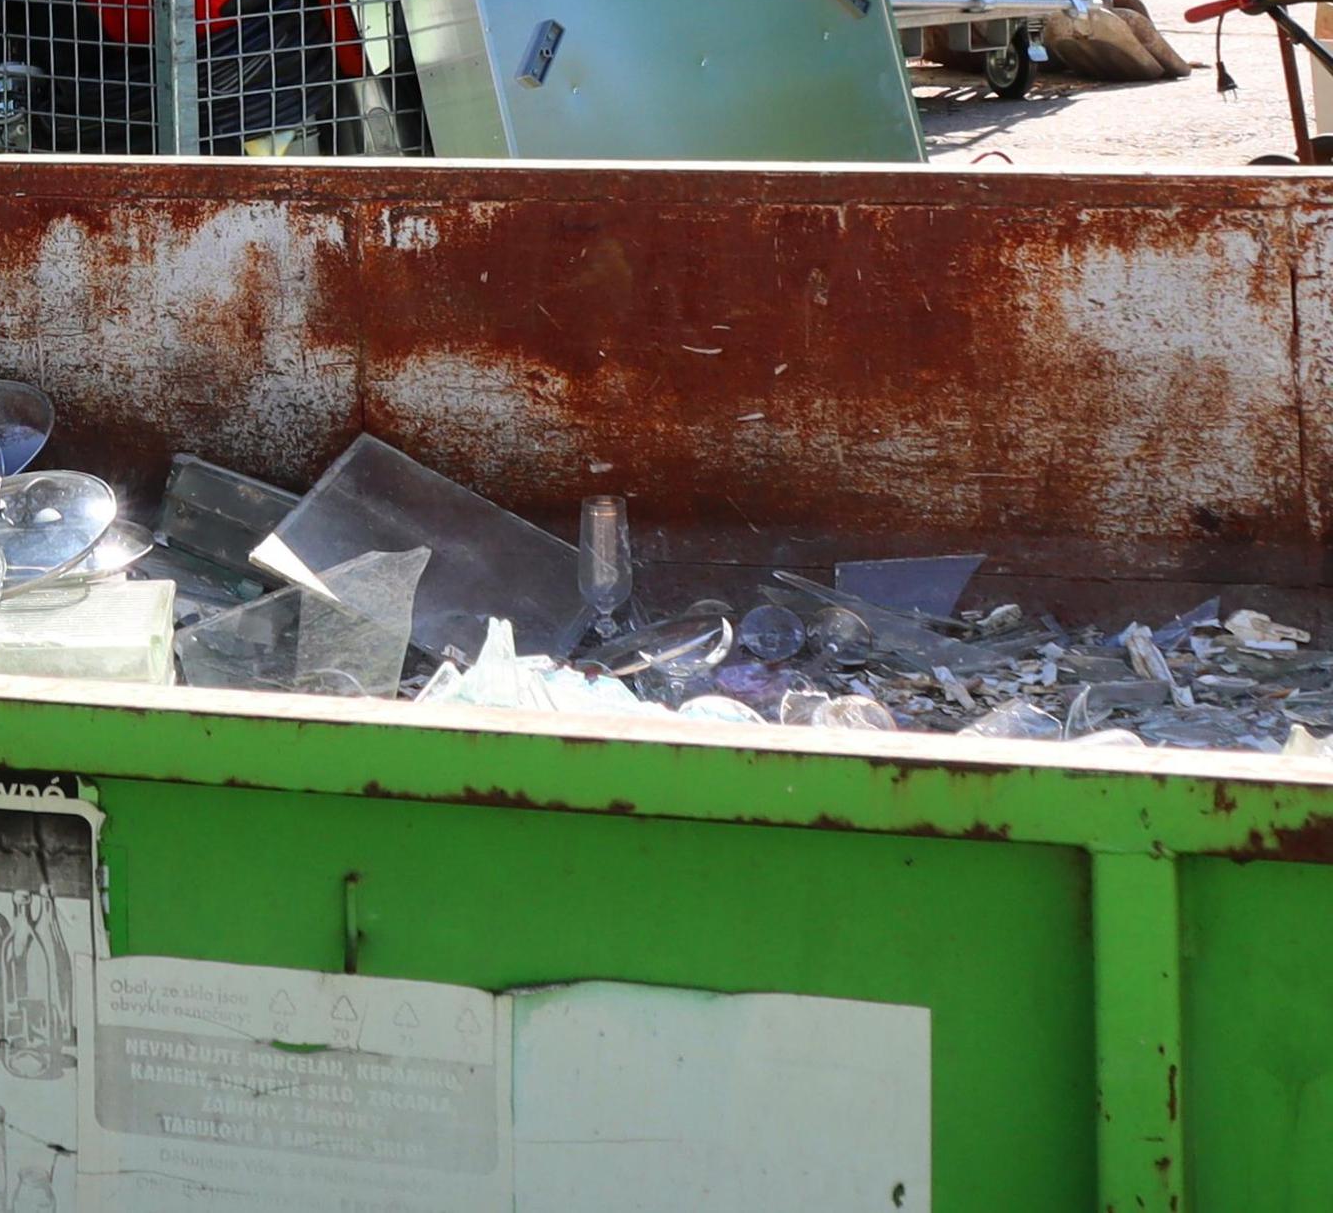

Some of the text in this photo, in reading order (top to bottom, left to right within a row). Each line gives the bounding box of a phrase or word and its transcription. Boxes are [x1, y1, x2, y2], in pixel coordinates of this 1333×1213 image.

[109, 978, 156, 1002] Obaly
[333, 1027, 350, 1041] 70
[124, 1037, 242, 1067] NEVHAZUJTE
[247, 1051, 350, 1081] PORCELÁN,
